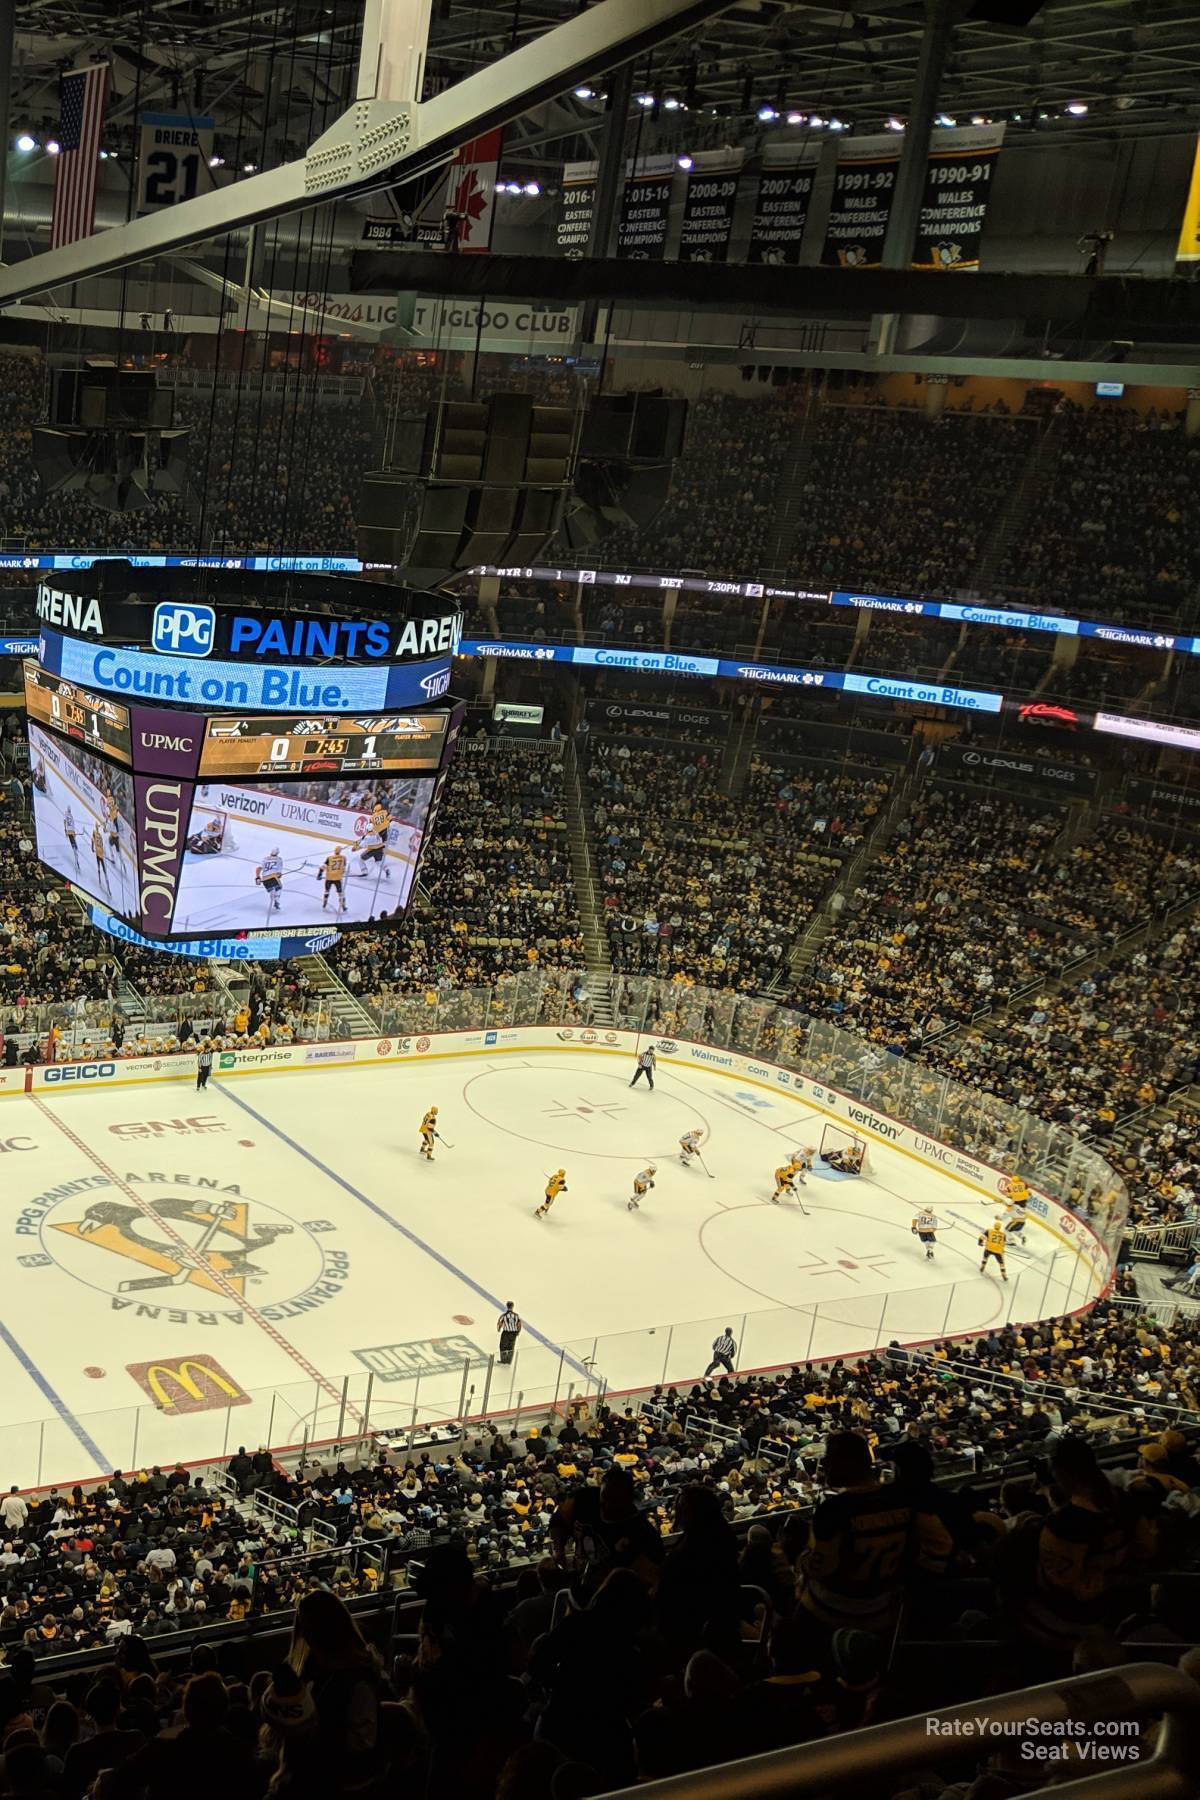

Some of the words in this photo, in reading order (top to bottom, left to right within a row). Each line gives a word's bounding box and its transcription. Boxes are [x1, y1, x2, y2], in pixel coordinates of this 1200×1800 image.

[154, 128, 200, 147] BRIERE
[145, 151, 199, 204] 21
[837, 172, 895, 190] 1991-92
[929, 163, 990, 184] 1990-91
[690, 182, 737, 199] 2008-09
[760, 177, 811, 194] 2007-08
[844, 197, 878, 209] WALES
[938, 190, 974, 204] WALES
[628, 208, 661, 219] EASTERN
[691, 205, 727, 217] EASTERN
[762, 201, 800, 212] EASTERN
[921, 204, 986, 221] CONFERENCE
[829, 210, 888, 223] CONFERENCE
[828, 225, 885, 238] CHAMPIONS
[920, 221, 981, 235] CHAMPIONS
[515, 312, 570, 334] CLUB
[271, 558, 301, 570] Count
[305, 561, 319, 570] on
[615, 574, 631, 585] NJ
[660, 577, 683, 588] DET
[708, 581, 740, 594] 7:30PM
[854, 598, 904, 612] HIGHMARK
[960, 608, 1002, 623] Count
[1006, 614, 1024, 626] on
[1027, 616, 1061, 632] Blue.
[157, 608, 210, 649] PPG
[230, 616, 390, 658] PAINTS
[1100, 630, 1153, 646] HIGHMARK
[482, 646, 533, 658] HIGHMARK
[594, 650, 637, 666] Count
[642, 655, 660, 668] on
[664, 655, 699, 671] Blue.
[93, 650, 191, 699] Count
[201, 678, 247, 704] on
[261, 669, 349, 707] Blue.
[744, 667, 800, 683] HIGHMARK
[867, 679, 913, 700] Count
[917, 687, 937, 701] on
[941, 689, 981, 709] Blue.
[51, 696, 60, 718] 0
[623, 709, 669, 720] LEXUS
[680, 712, 710, 725] LOGES
[141, 731, 193, 753] UPMC
[270, 738, 290, 761] 0
[316, 740, 345, 754] 7:45
[361, 736, 377, 759] 1
[467, 743, 485, 752] 104
[983, 757, 1034, 773] LEXUS
[1042, 766, 1076, 781] LOGES
[220, 792, 267, 815] verizon
[280, 803, 315, 823] UPMC
[141, 784, 182, 920] UPMC
[297, 926, 337, 937] ELECTRIC
[198, 939, 255, 959] Blue.
[397, 1038, 411, 1050] IC
[126, 1063, 154, 1072] VECTOR
[691, 1047, 733, 1067] Walmart
[747, 1063, 769, 1078] com
[43, 1062, 116, 1082] GEICO
[107, 1114, 227, 1136] GNC
[847, 1104, 898, 1140] verizon
[914, 1136, 953, 1166] UPMC
[957, 1156, 981, 1174] SPORTS
[15, 1207, 45, 1236] PPG
[31, 1174, 110, 1211] PAINTS
[125, 1172, 242, 1195] ARENA
[324, 1249, 350, 1280] PPG
[259, 1279, 346, 1321] PAINTS
[111, 1297, 244, 1326] ARENA
